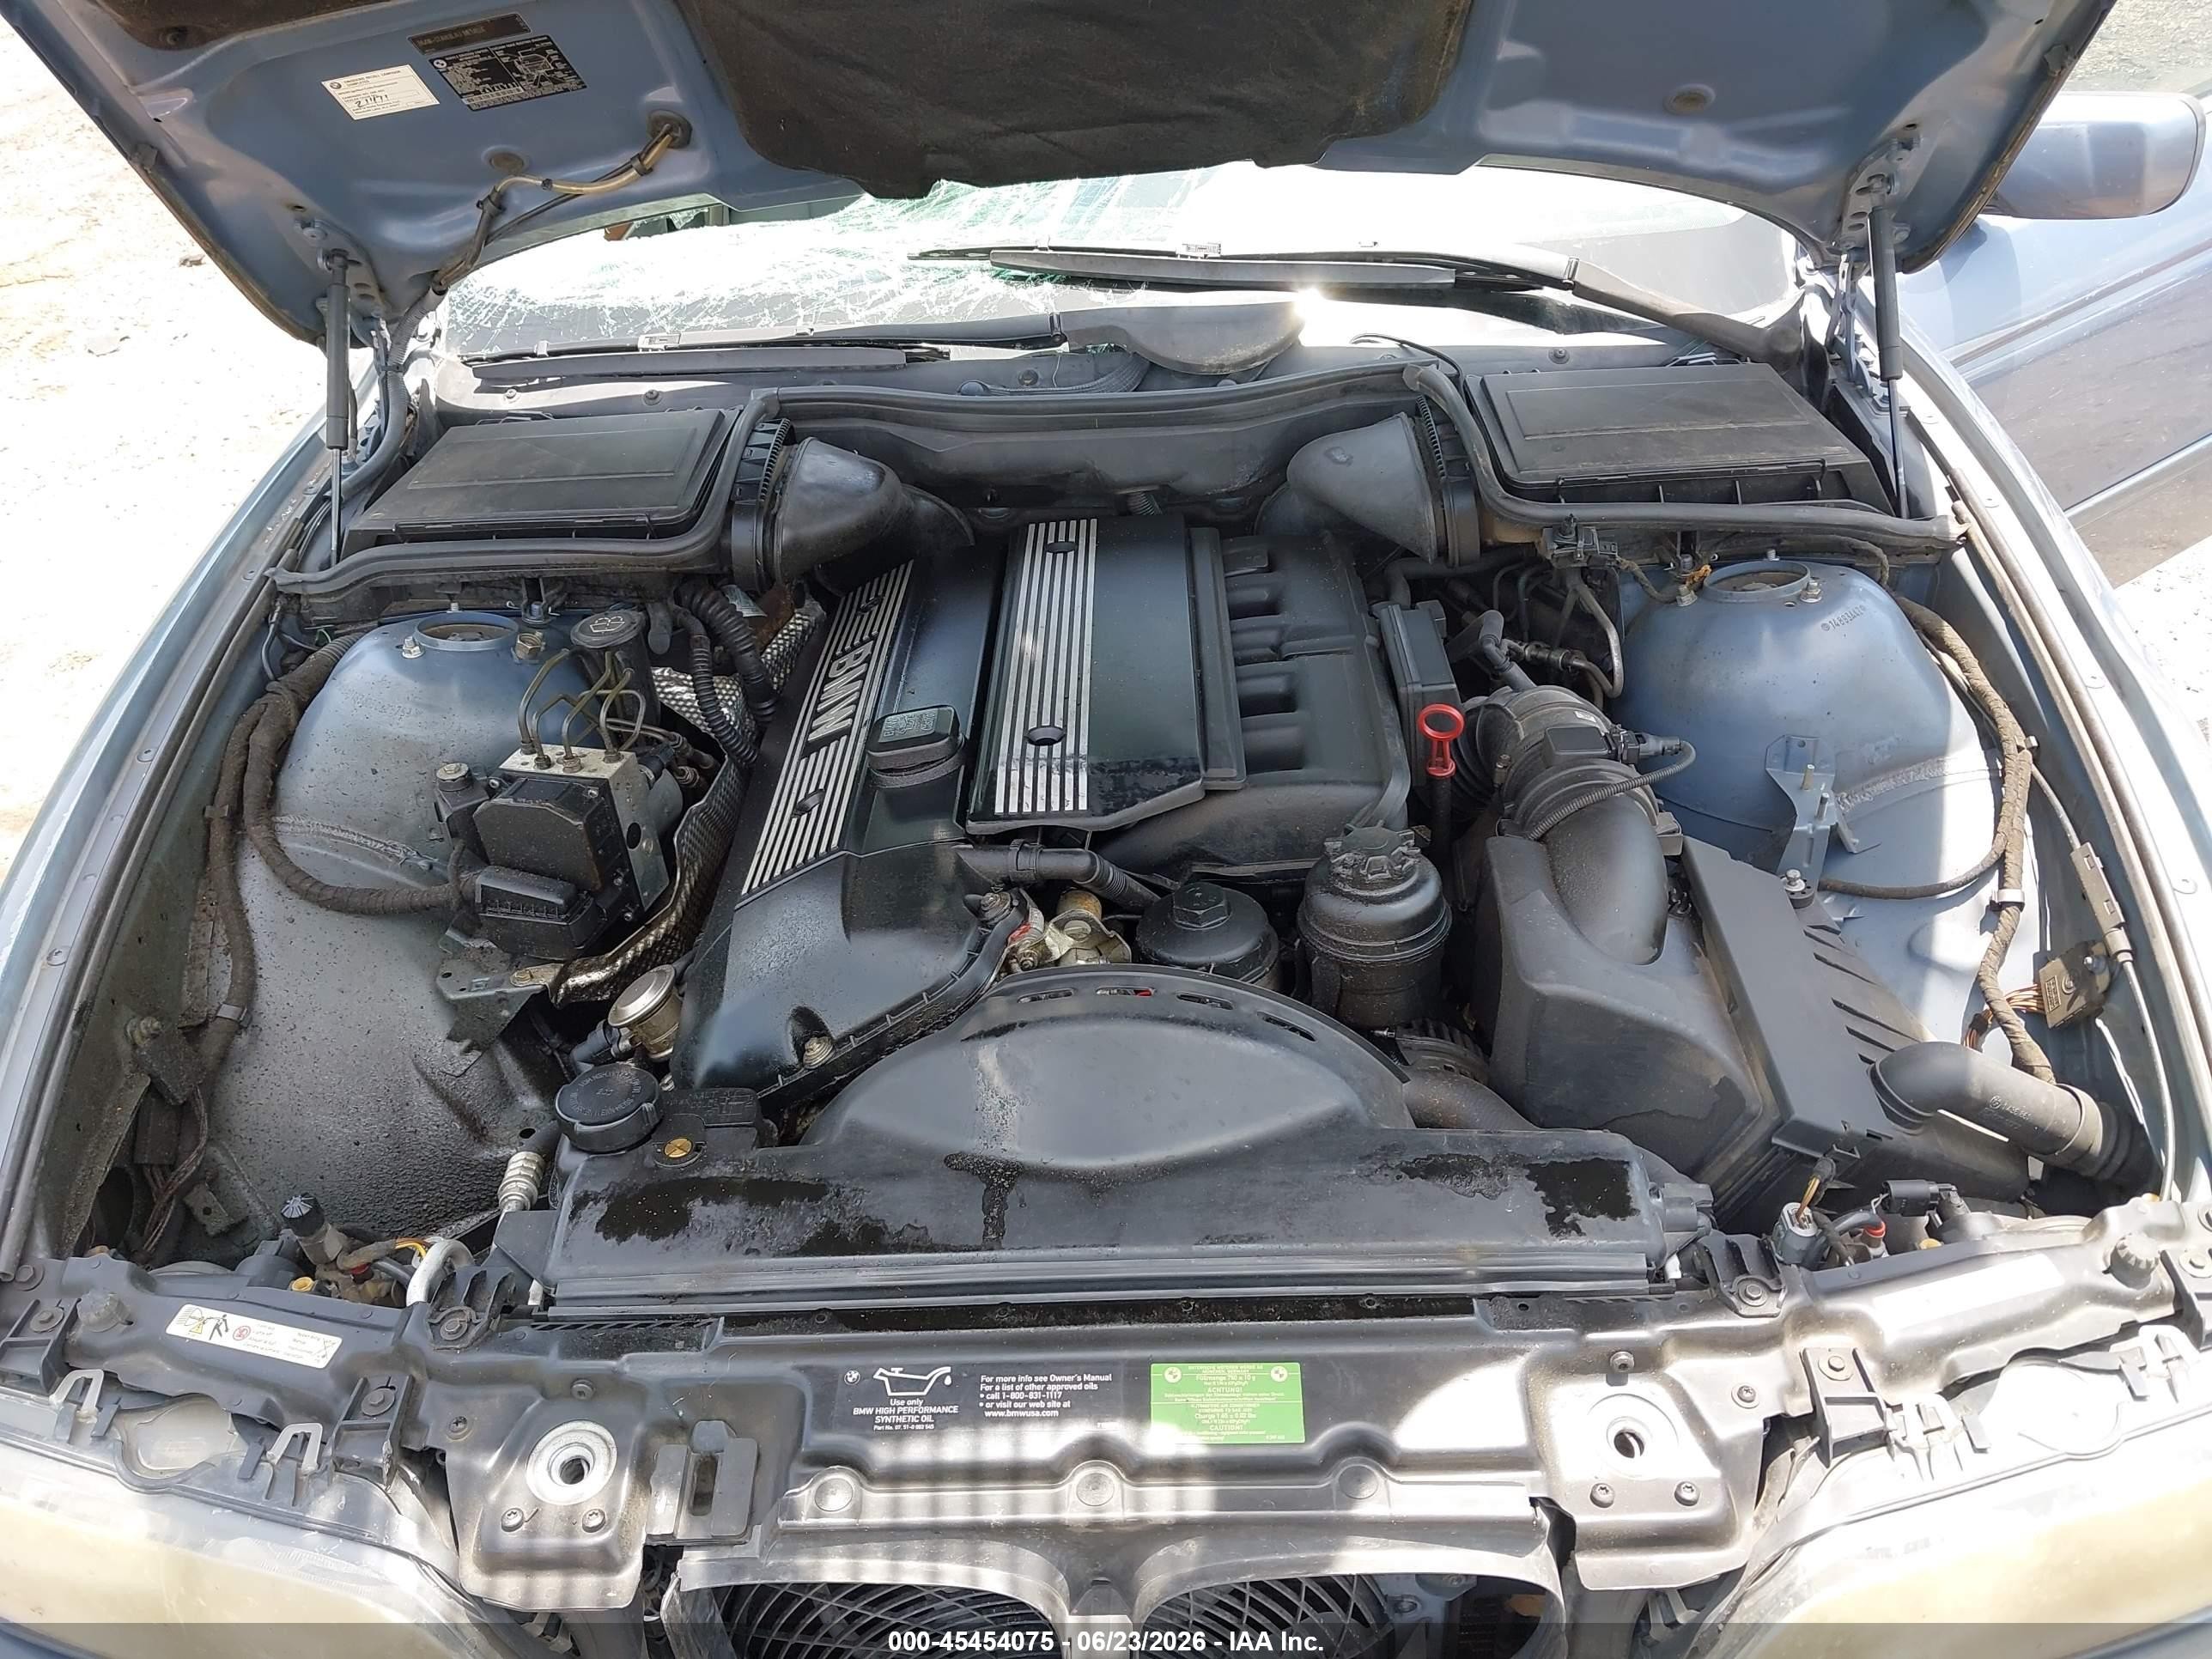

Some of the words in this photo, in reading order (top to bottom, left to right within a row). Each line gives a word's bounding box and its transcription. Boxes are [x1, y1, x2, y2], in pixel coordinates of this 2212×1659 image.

[808, 641, 873, 742] BMW
[1018, 1374, 1032, 1382] info
[1046, 1382, 1083, 1393] approved
[908, 1398, 924, 1407] only
[875, 1407, 896, 1415] HIGH
[897, 1406, 958, 1414] PERFORMANCE
[985, 1409, 1059, 1418] www.bmwusa.com
[875, 1415, 921, 1424] SYNTHETIC
